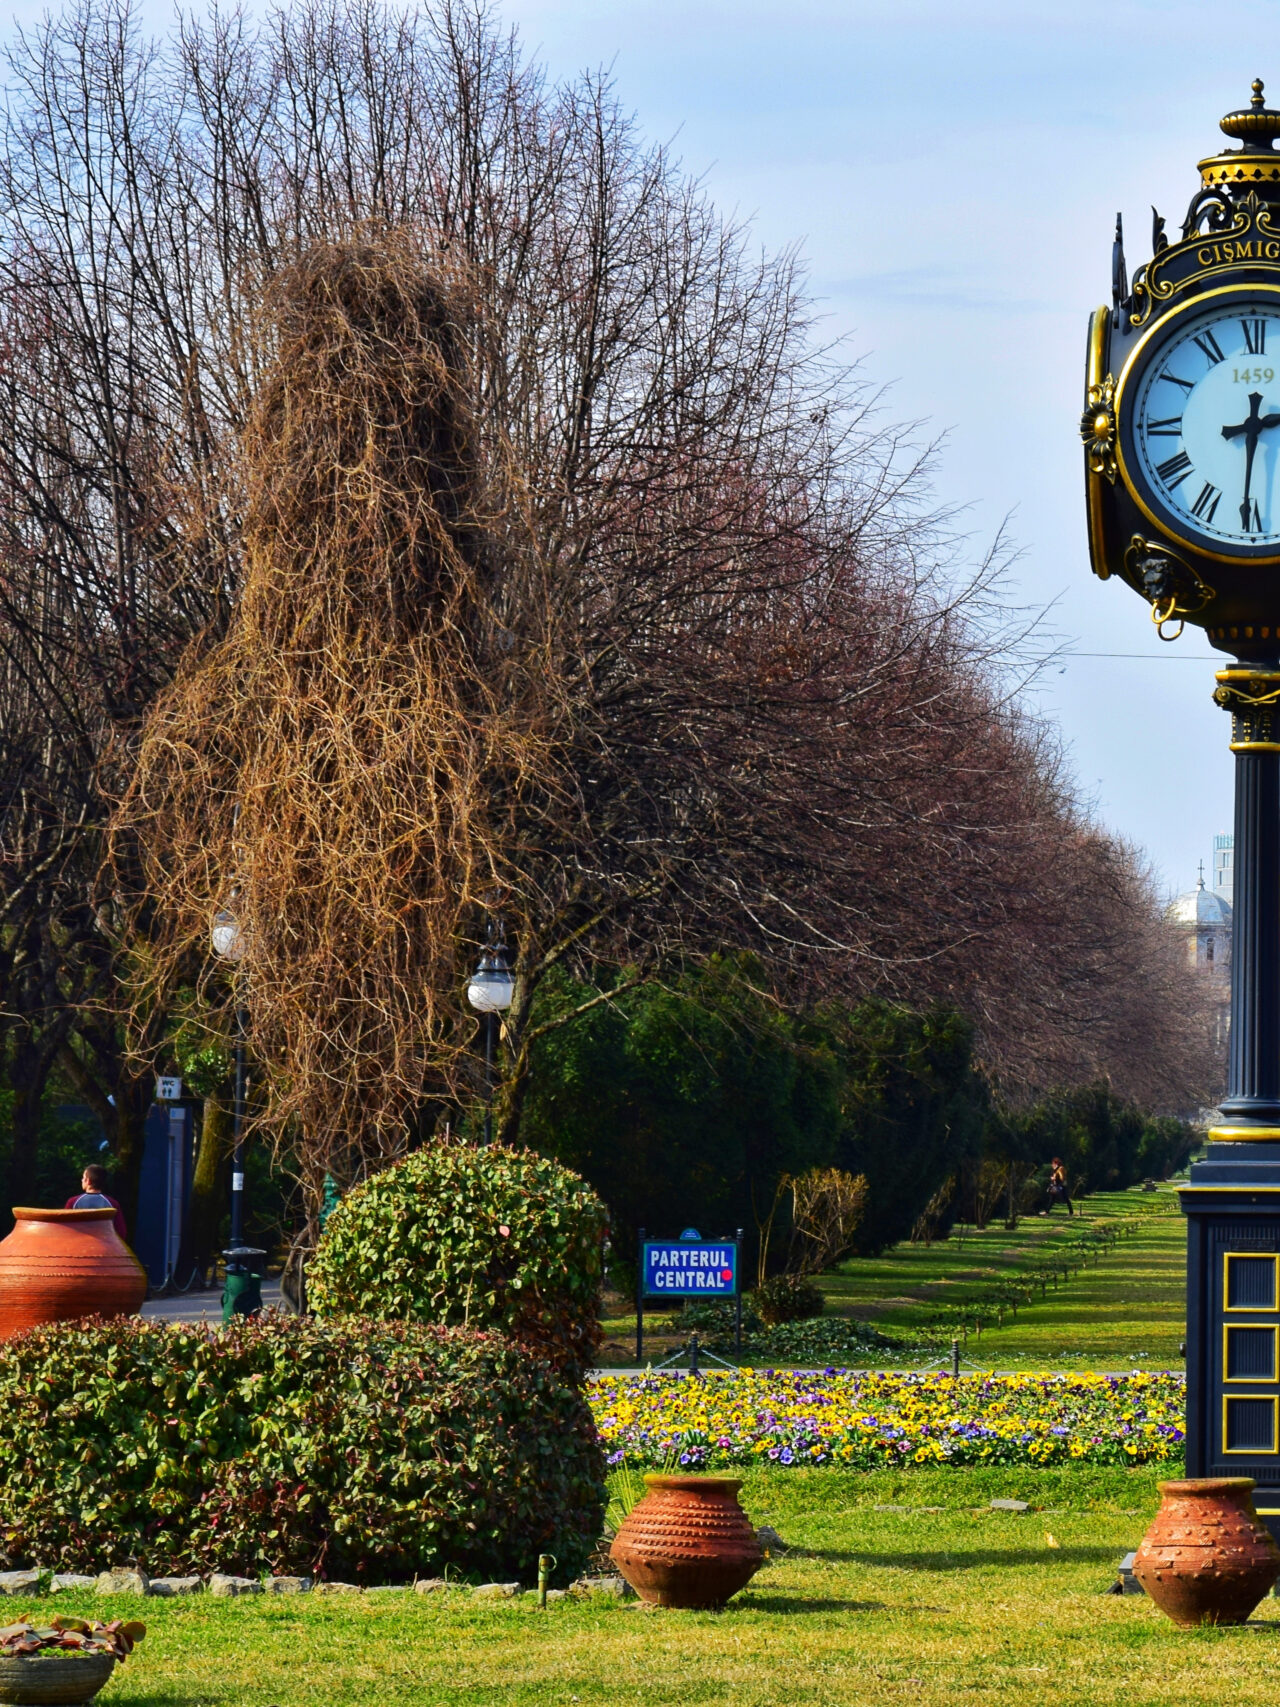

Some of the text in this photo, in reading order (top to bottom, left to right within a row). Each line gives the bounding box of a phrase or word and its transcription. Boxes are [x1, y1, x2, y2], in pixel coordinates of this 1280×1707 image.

[1189, 328, 1229, 371] XI
[1239, 319, 1269, 356] XII
[1156, 363, 1198, 400] X
[1232, 368, 1274, 384] 1459
[1147, 413, 1183, 440] IX
[1154, 447, 1195, 495] VIII
[1189, 480, 1223, 526] VII
[651, 1251, 728, 1266] PARTERUL
[655, 1271, 724, 1287] CENTRAL
